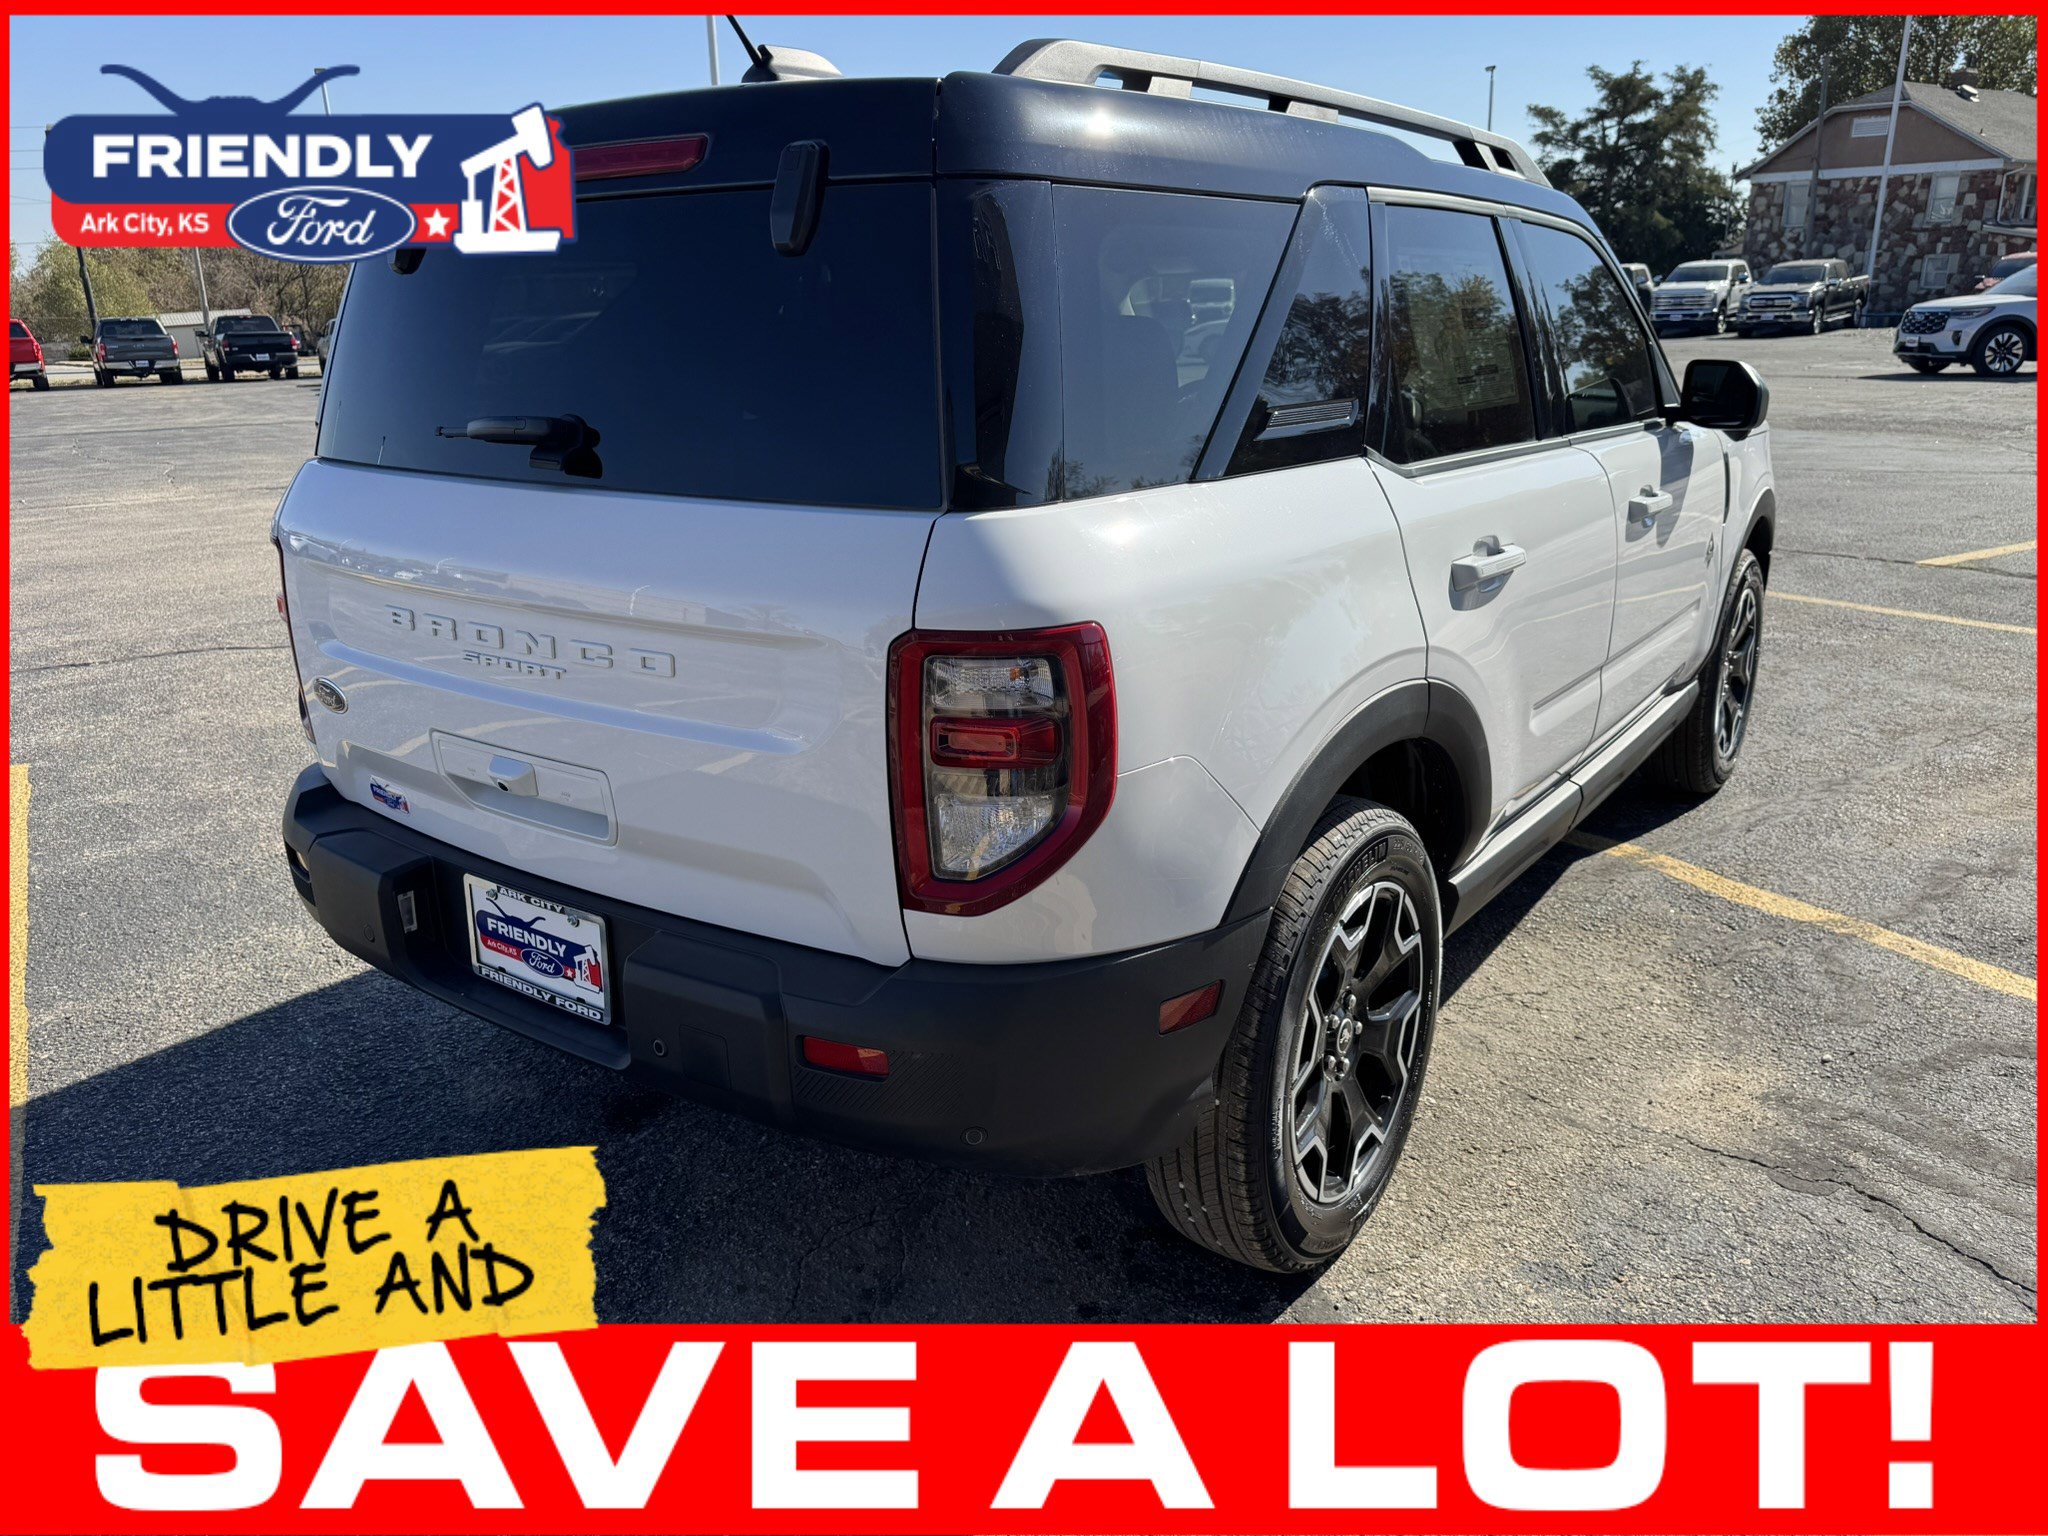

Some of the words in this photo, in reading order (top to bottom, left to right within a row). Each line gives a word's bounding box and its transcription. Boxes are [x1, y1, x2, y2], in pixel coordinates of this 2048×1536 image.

[385, 604, 676, 678] BRONCO
[462, 650, 567, 679] SPORT
[499, 887, 527, 902] ARK
[530, 898, 564, 913] CITY
[487, 917, 567, 957] FRIENDLY
[529, 951, 555, 974] Ford
[481, 968, 551, 1001] FRIENDLY
[555, 998, 601, 1020] FORD
